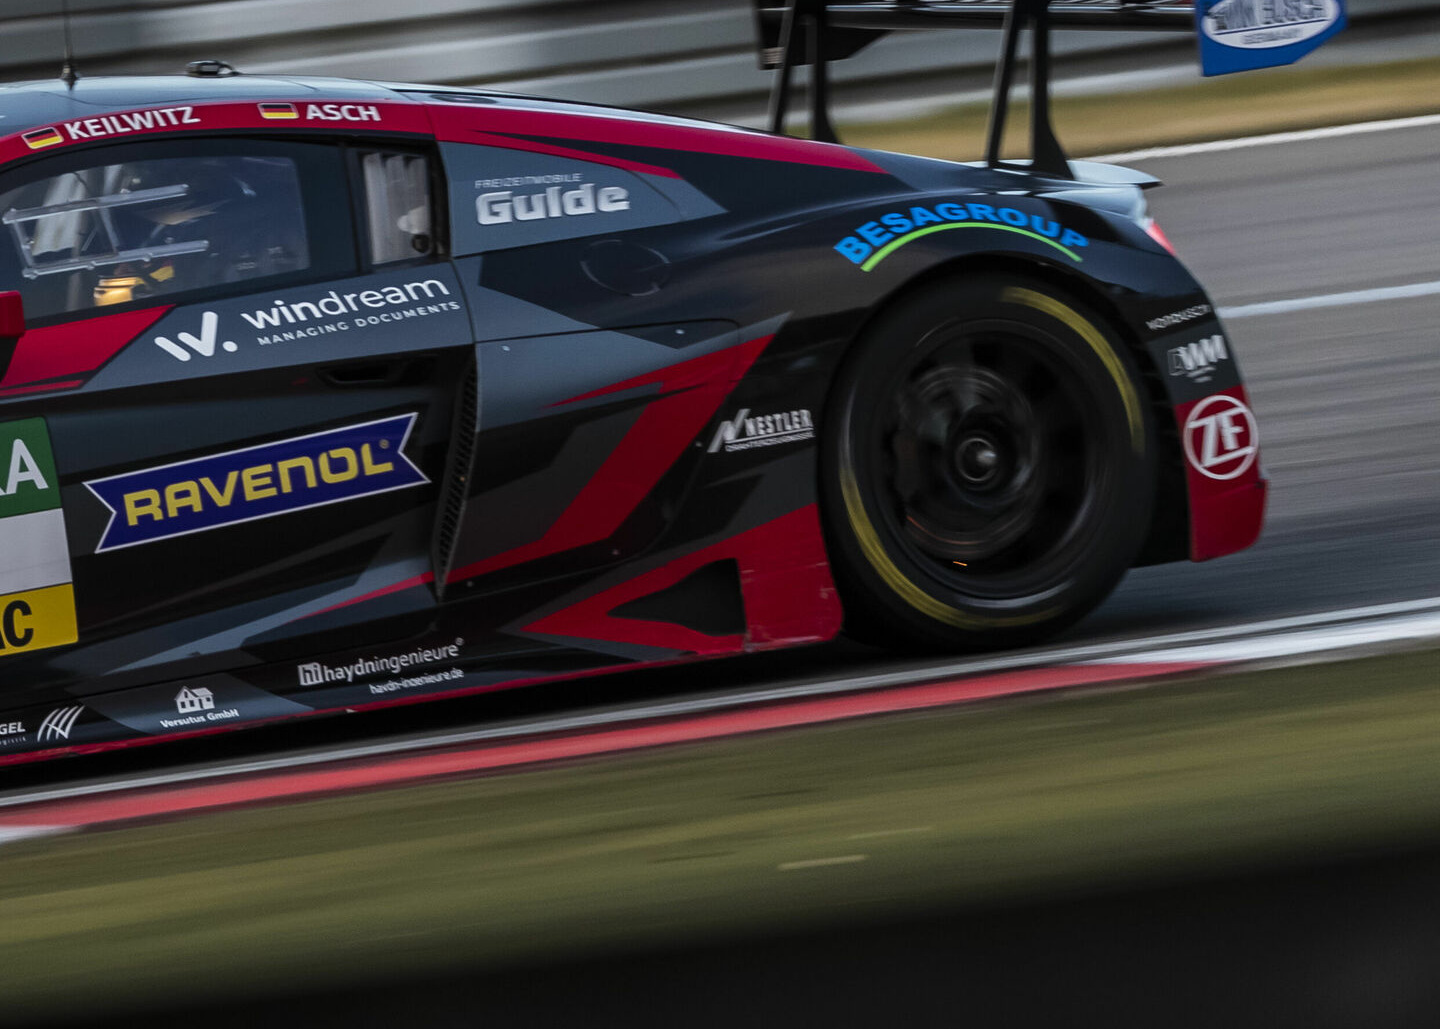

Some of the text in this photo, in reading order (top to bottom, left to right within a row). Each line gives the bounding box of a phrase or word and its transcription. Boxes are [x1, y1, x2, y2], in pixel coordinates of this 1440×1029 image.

[64, 106, 201, 140] KEILWITZ
[306, 104, 382, 122] ASCH
[833, 203, 1089, 264] BESAGROUP
[241, 279, 451, 330] windream
[257, 301, 461, 346] MANAGING DOCUMENTS
[1187, 406, 1257, 469] ZF
[123, 443, 394, 526] RAVENOL
[324, 645, 459, 682] haydningenieure
[160, 709, 239, 728] Versutus GmbH
